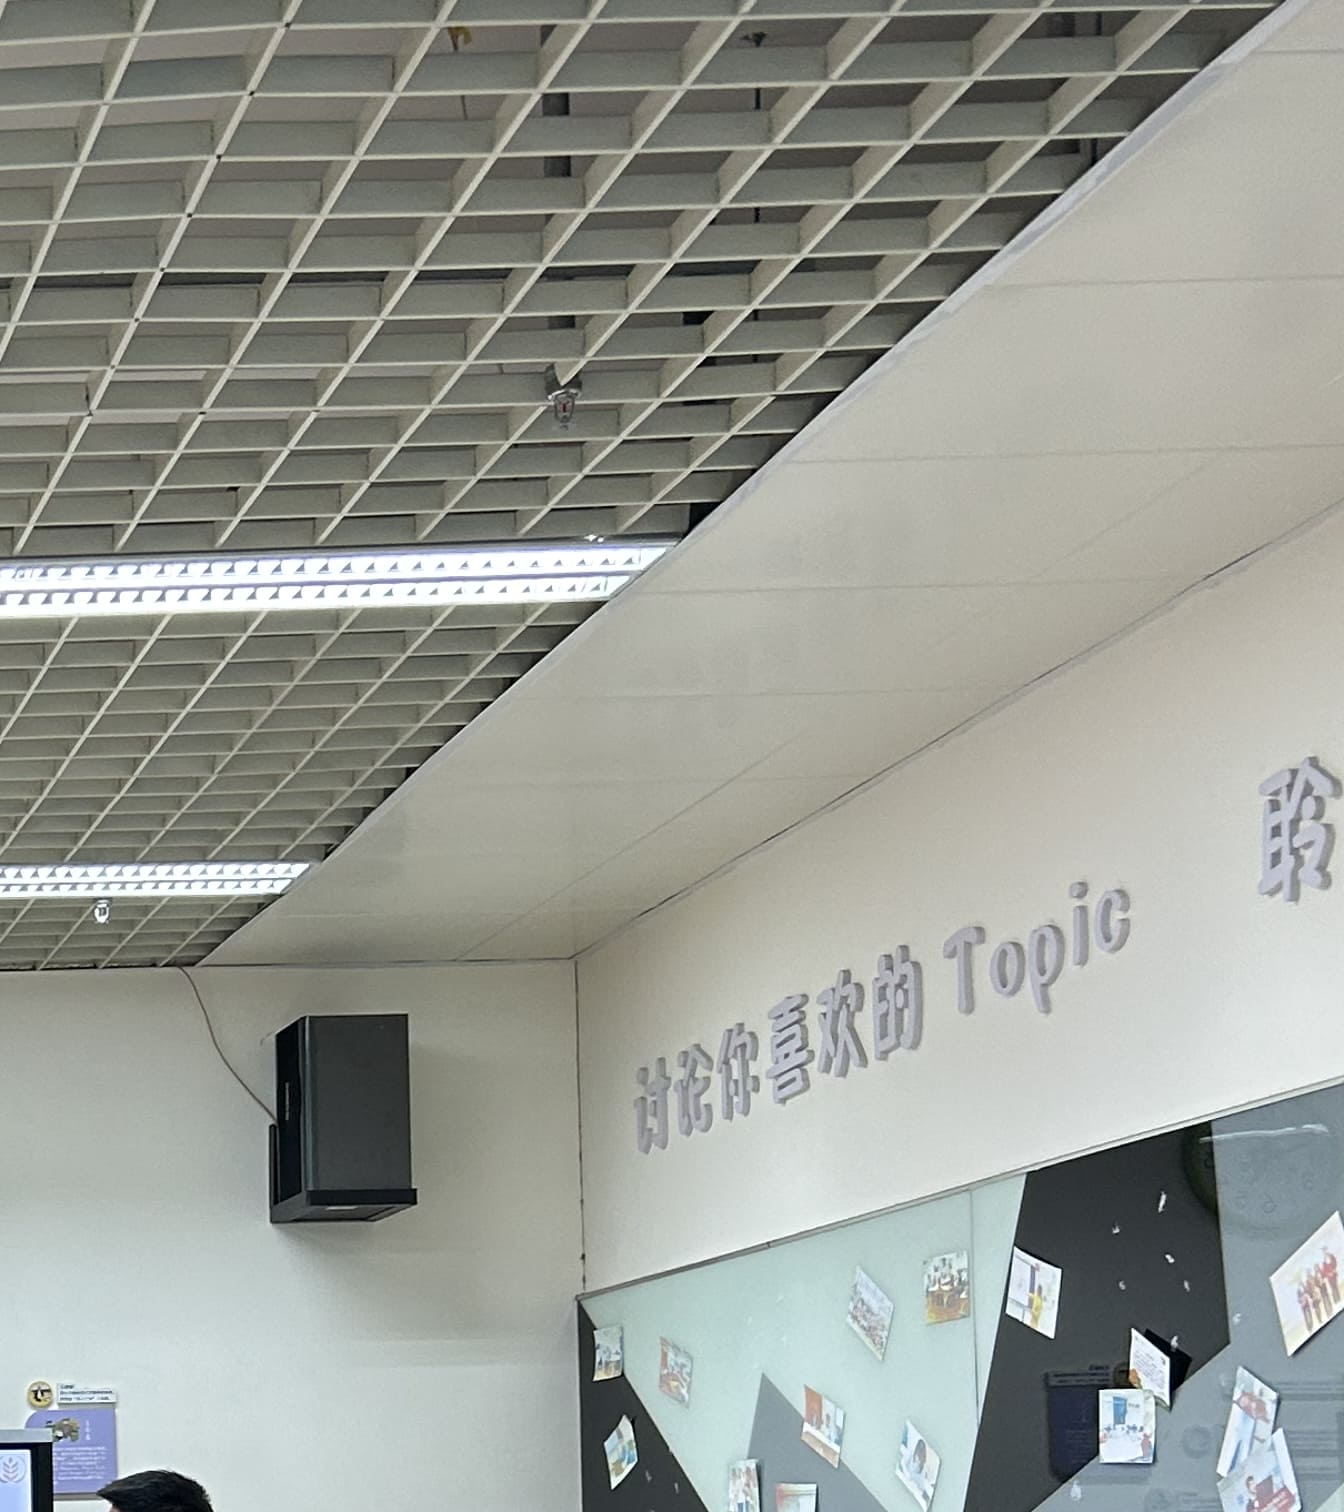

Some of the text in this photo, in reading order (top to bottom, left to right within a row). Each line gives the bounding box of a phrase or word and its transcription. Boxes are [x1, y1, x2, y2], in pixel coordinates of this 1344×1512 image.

[1258, 756, 1343, 902] 聆
[633, 880, 1131, 1154] 讨论你喜欢的 Topic
